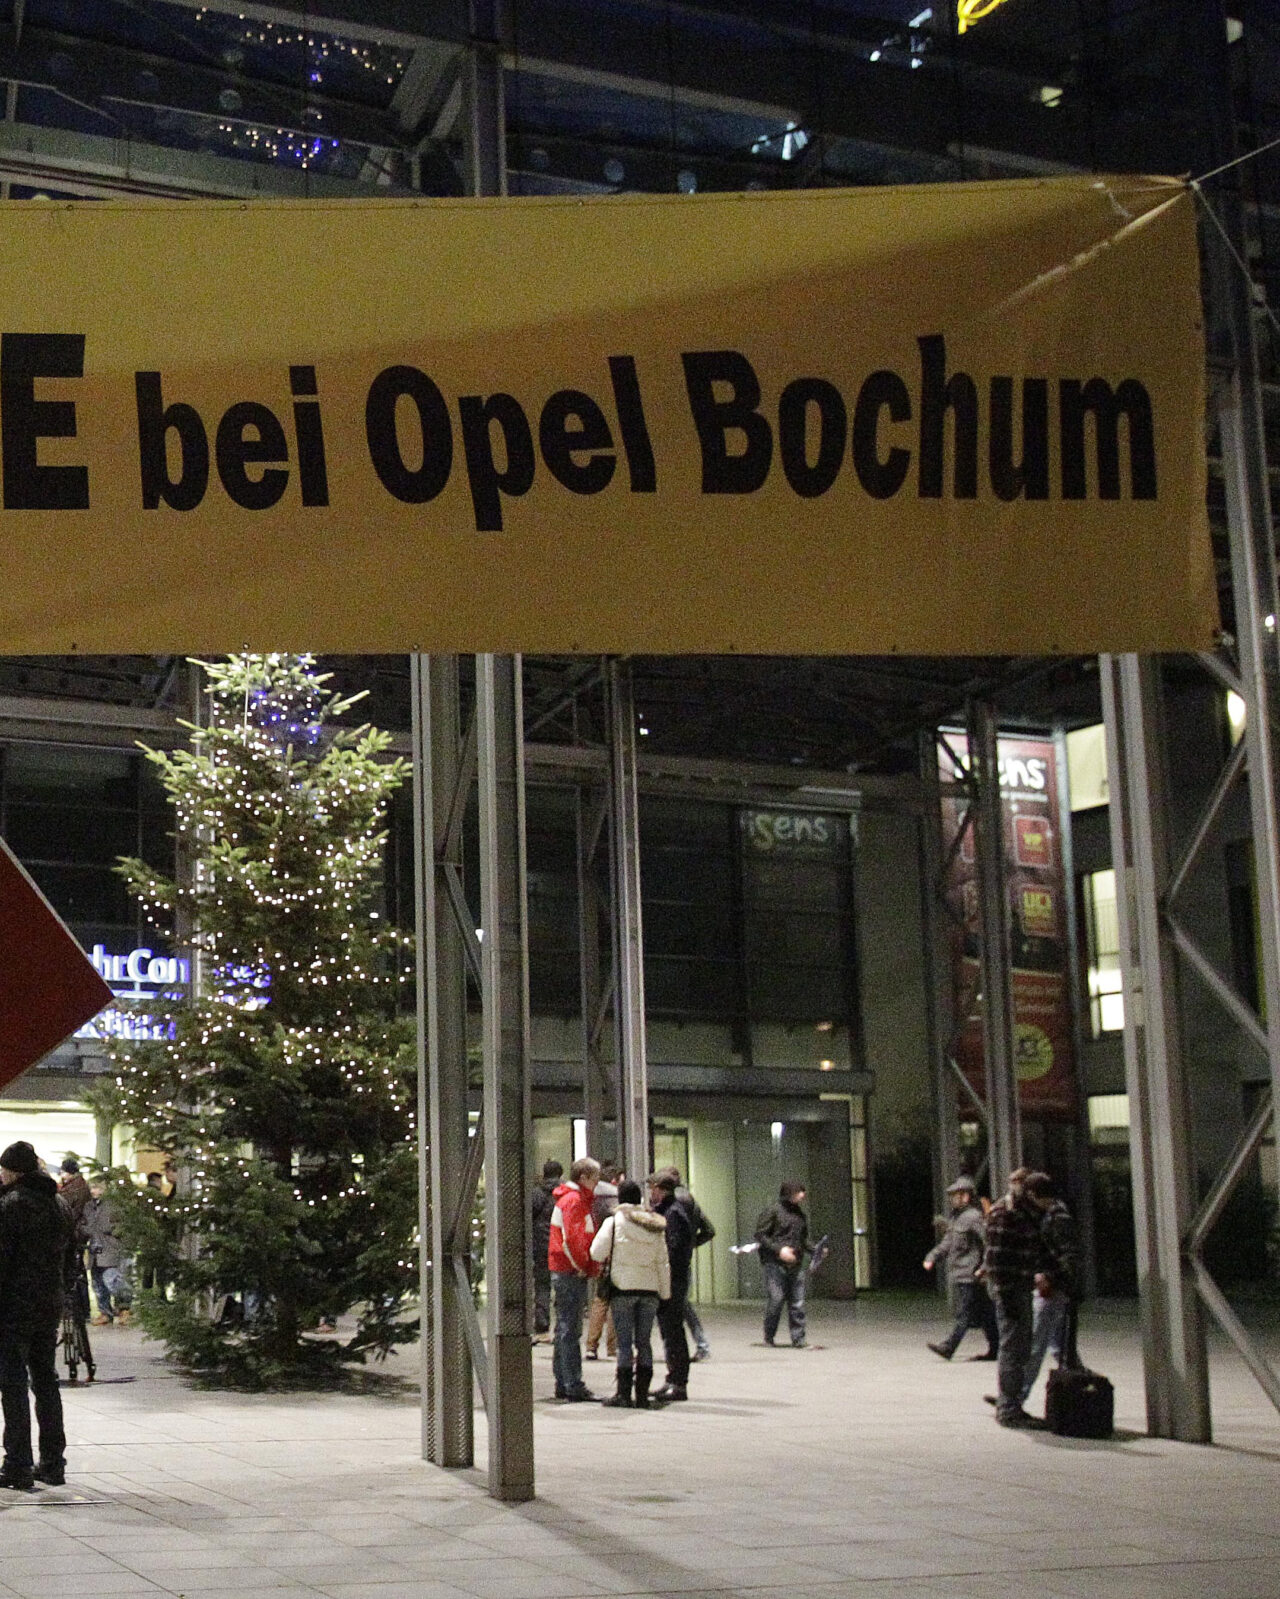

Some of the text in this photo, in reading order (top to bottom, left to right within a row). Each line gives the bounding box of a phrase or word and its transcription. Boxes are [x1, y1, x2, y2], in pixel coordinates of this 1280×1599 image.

[134, 364, 331, 513] bei
[363, 354, 658, 534] Opel
[680, 334, 1159, 502] Bochum
